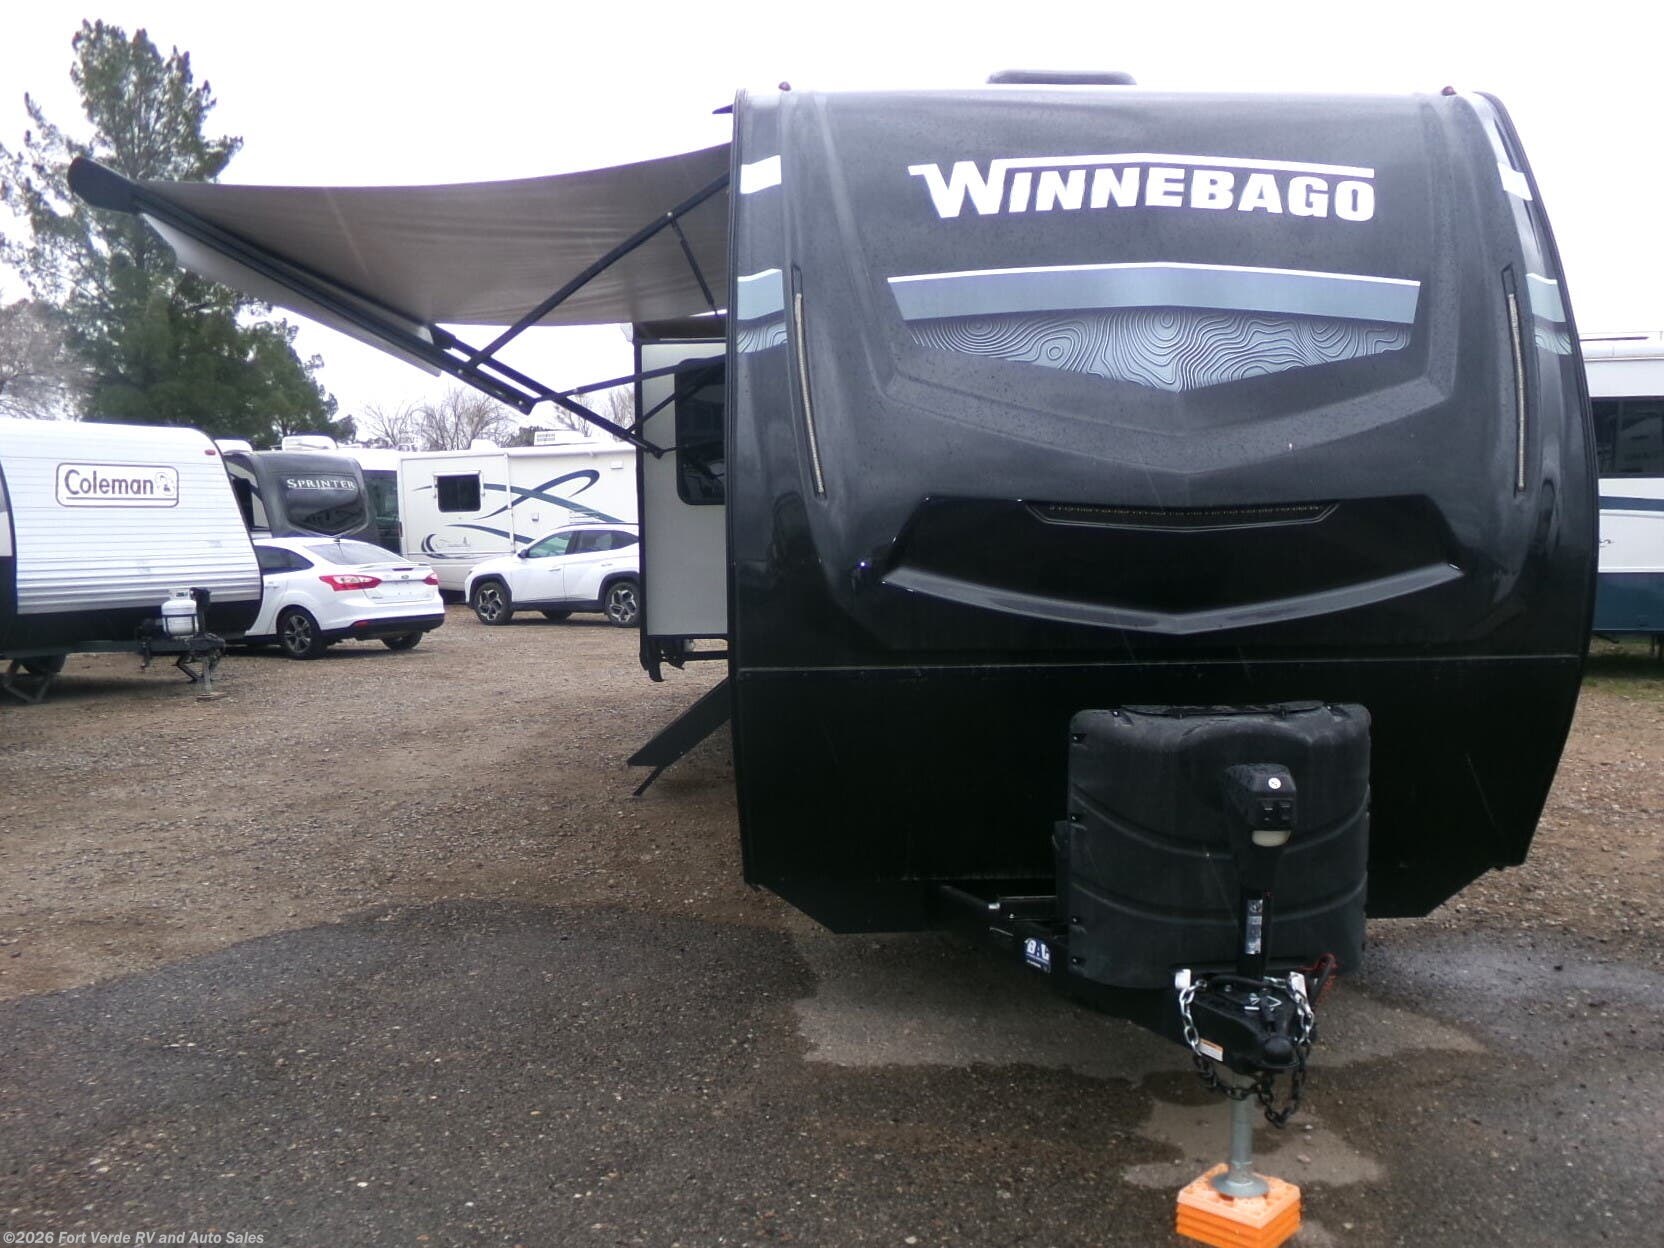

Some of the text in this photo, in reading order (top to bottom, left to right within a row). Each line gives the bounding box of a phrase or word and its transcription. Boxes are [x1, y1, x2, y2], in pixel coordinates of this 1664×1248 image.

[908, 152, 1376, 222] WINNEBAGO
[64, 468, 154, 495] Coleman
[286, 478, 356, 490] SPRINTER
